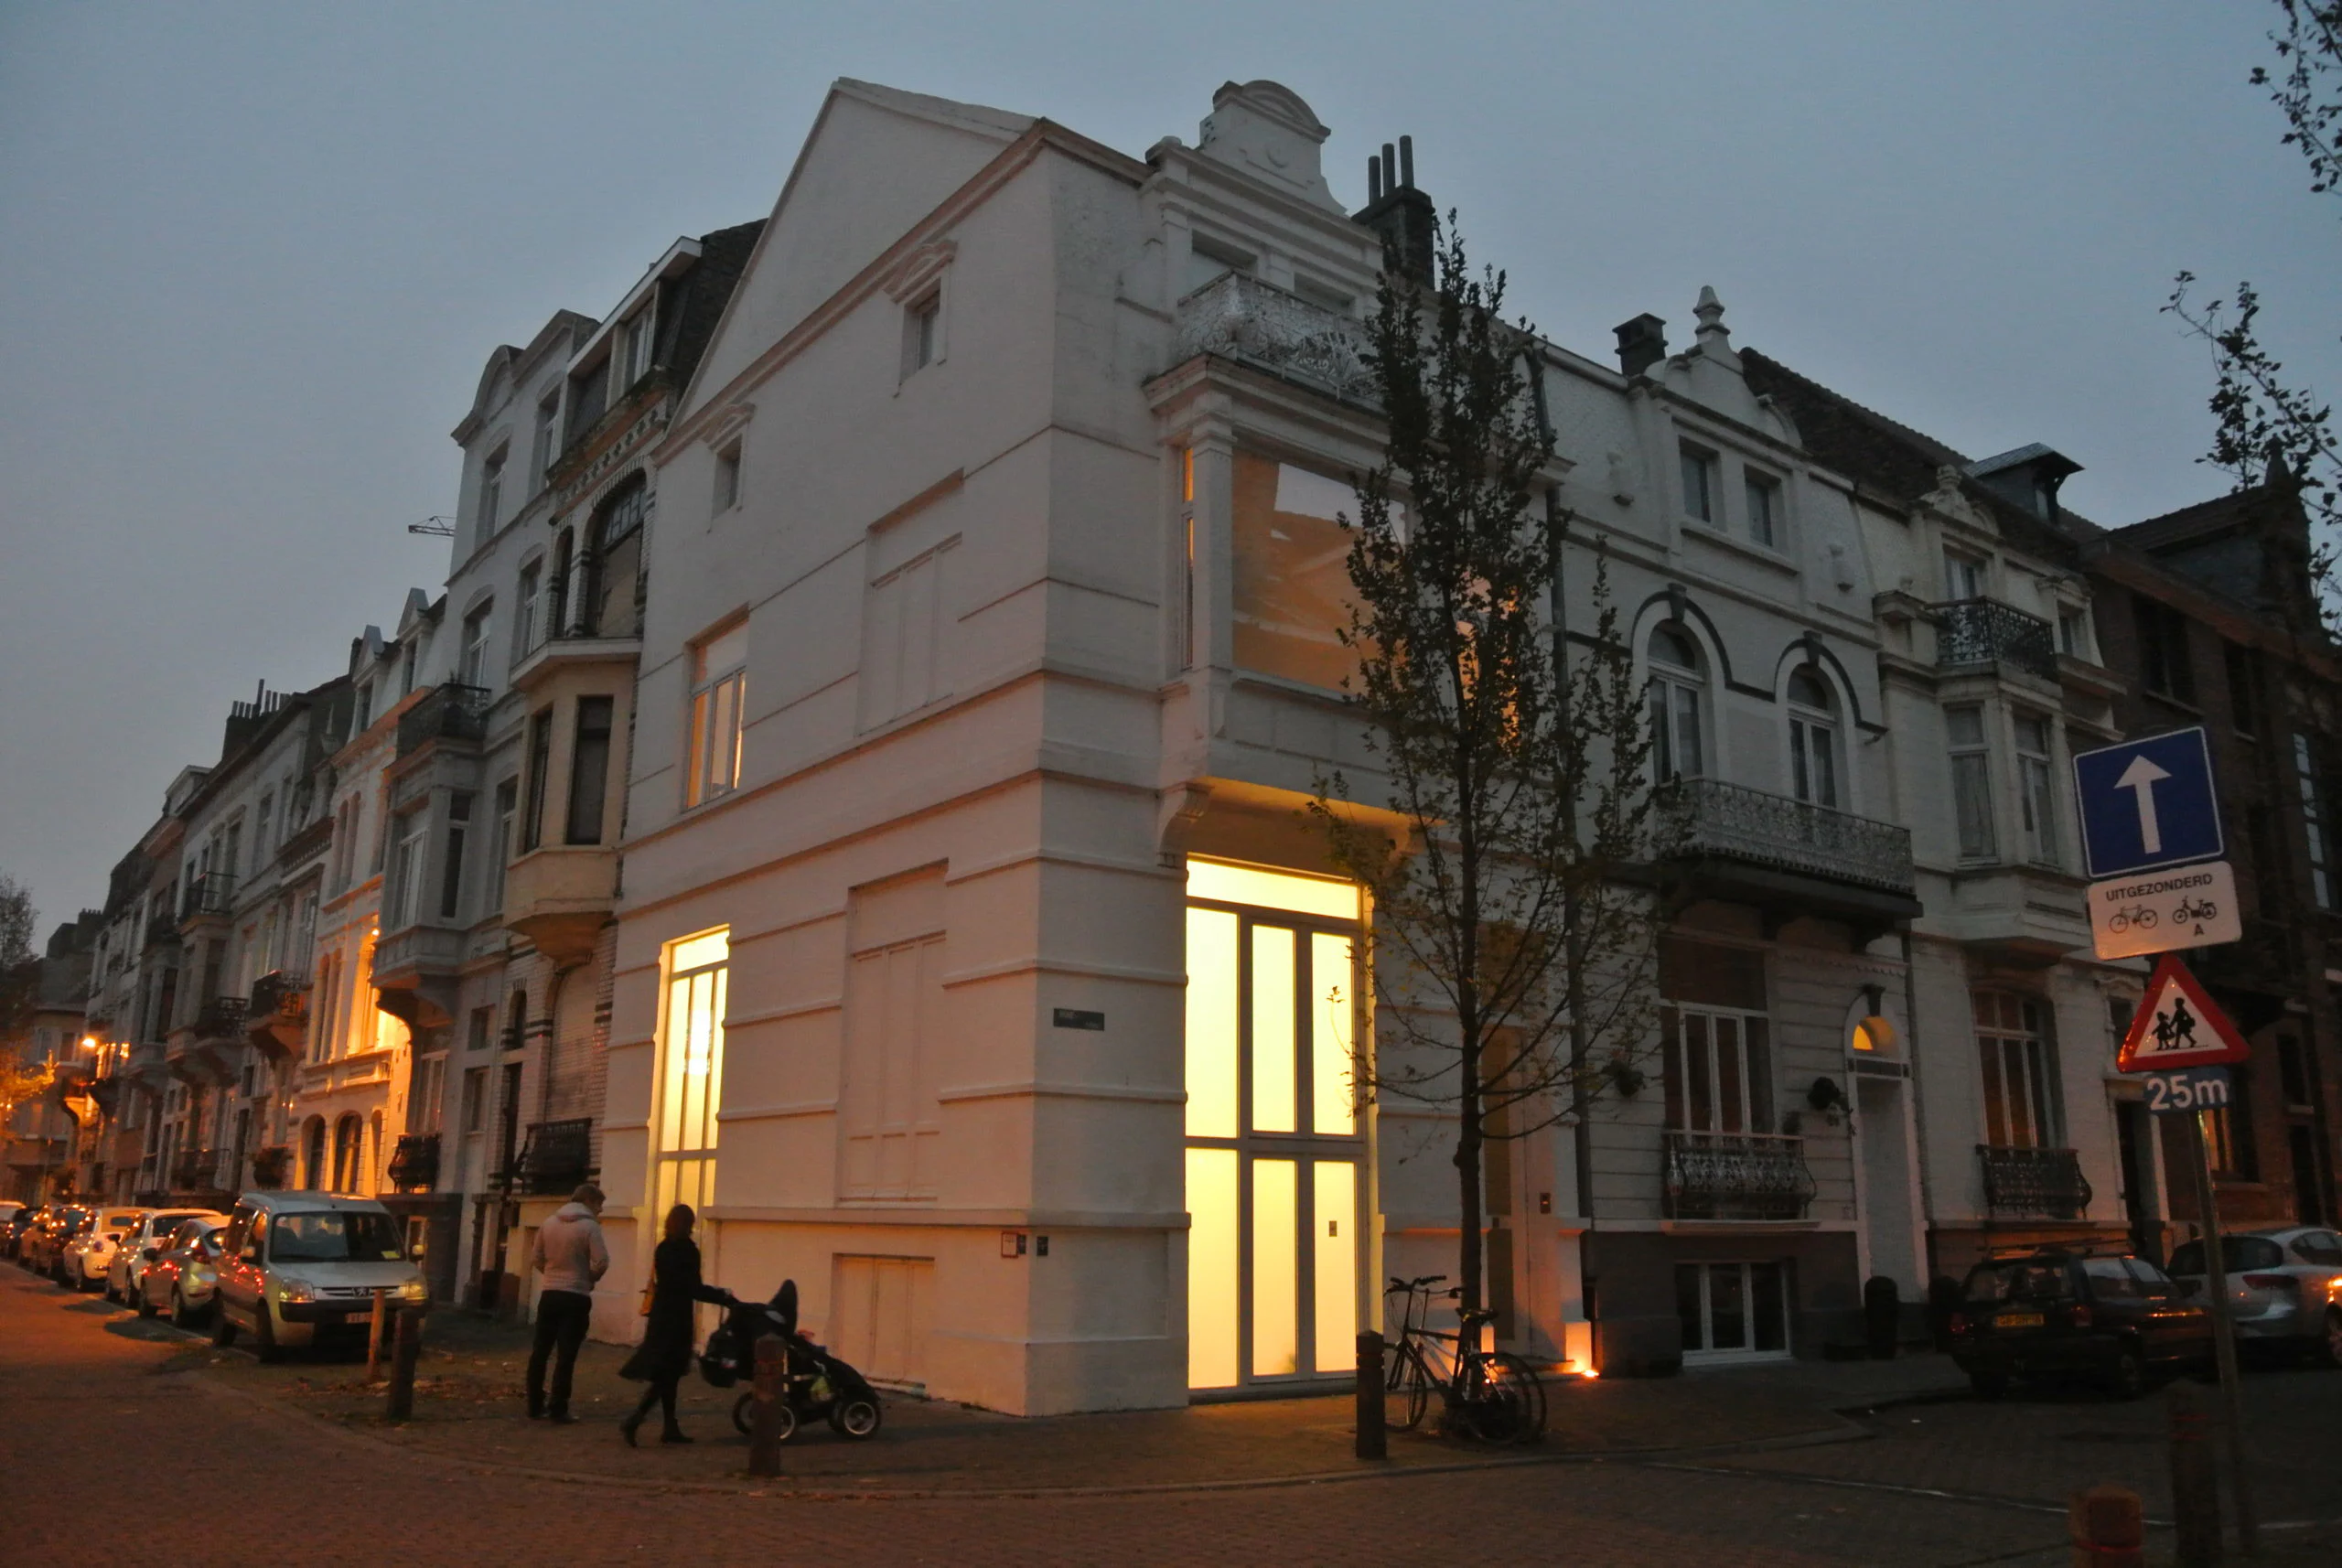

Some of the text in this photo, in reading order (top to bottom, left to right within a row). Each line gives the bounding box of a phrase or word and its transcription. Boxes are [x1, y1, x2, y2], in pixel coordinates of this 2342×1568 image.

[2106, 873, 2213, 901] UITGEZONDERD
[2194, 923, 2205, 937] A
[2147, 1074, 2228, 1111] 25m
